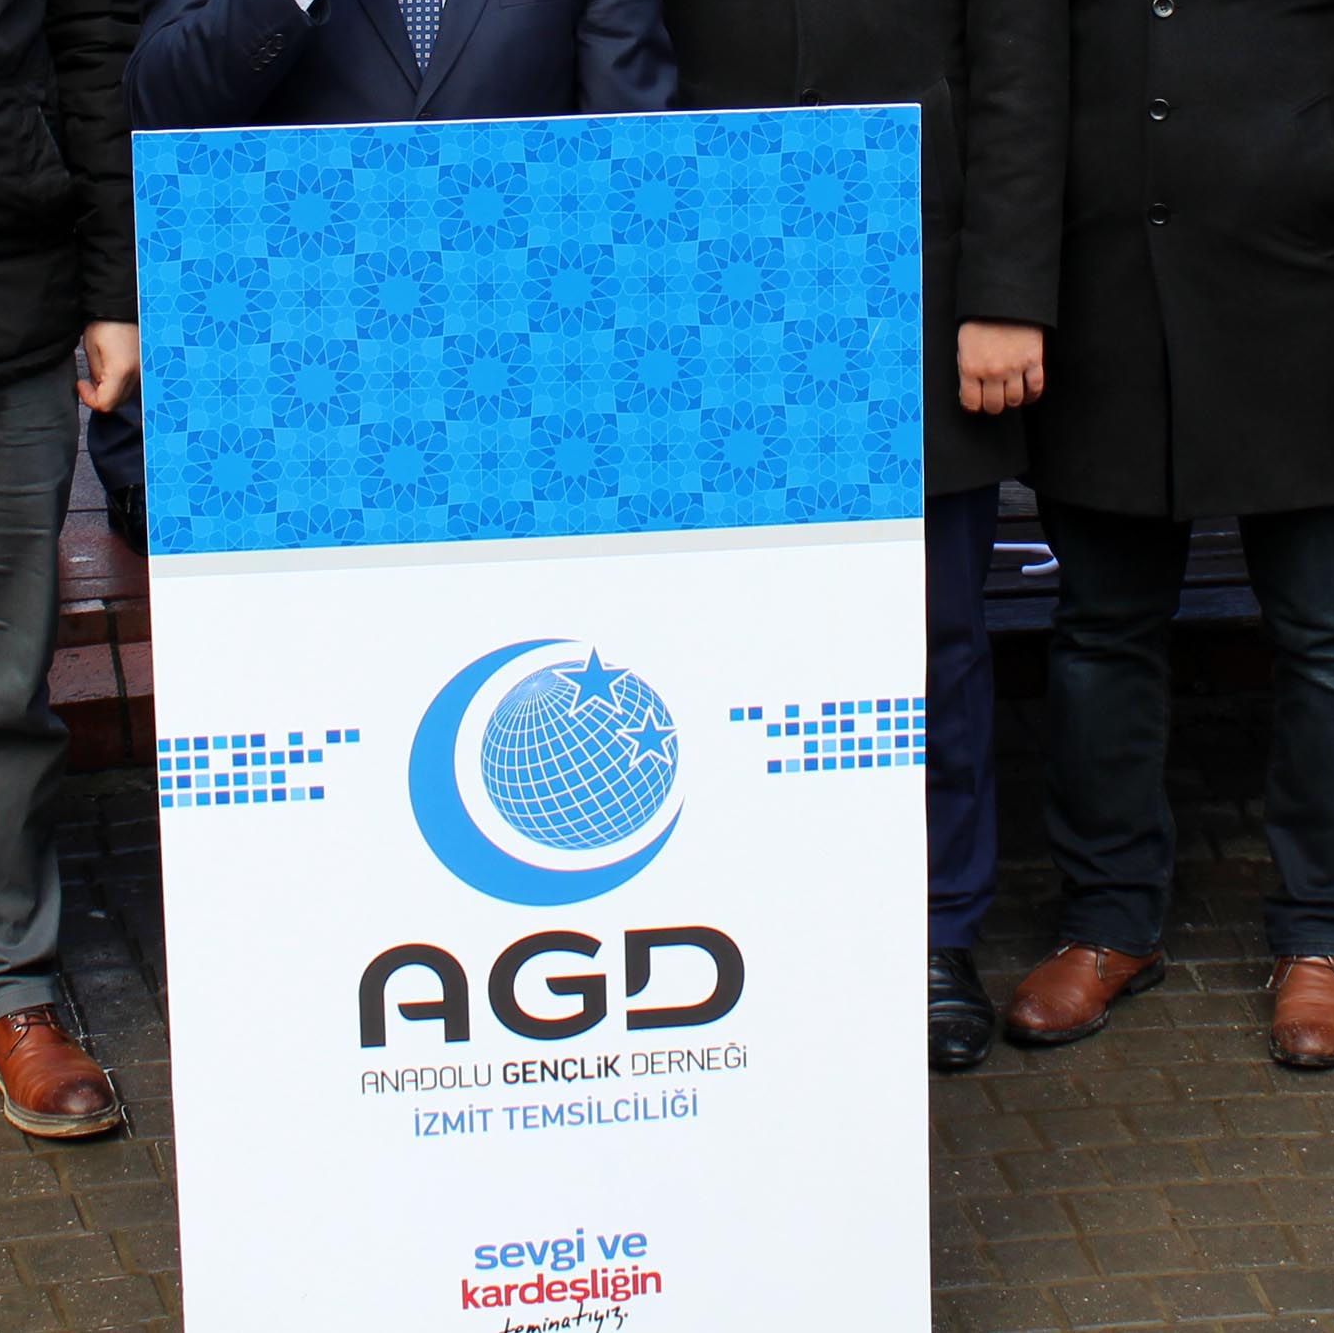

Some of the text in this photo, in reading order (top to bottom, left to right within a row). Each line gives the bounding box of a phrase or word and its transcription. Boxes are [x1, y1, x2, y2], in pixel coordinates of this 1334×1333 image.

[358, 924, 746, 1048] AGD
[361, 1042, 748, 1095] ANADOLU GENÇLİK DERNEĞİ
[413, 1087, 699, 1138] İZMİT TEMSİLCİLİĞİ
[473, 1227, 648, 1272] sevgi ve
[460, 1264, 663, 1310] kardeşliğin
